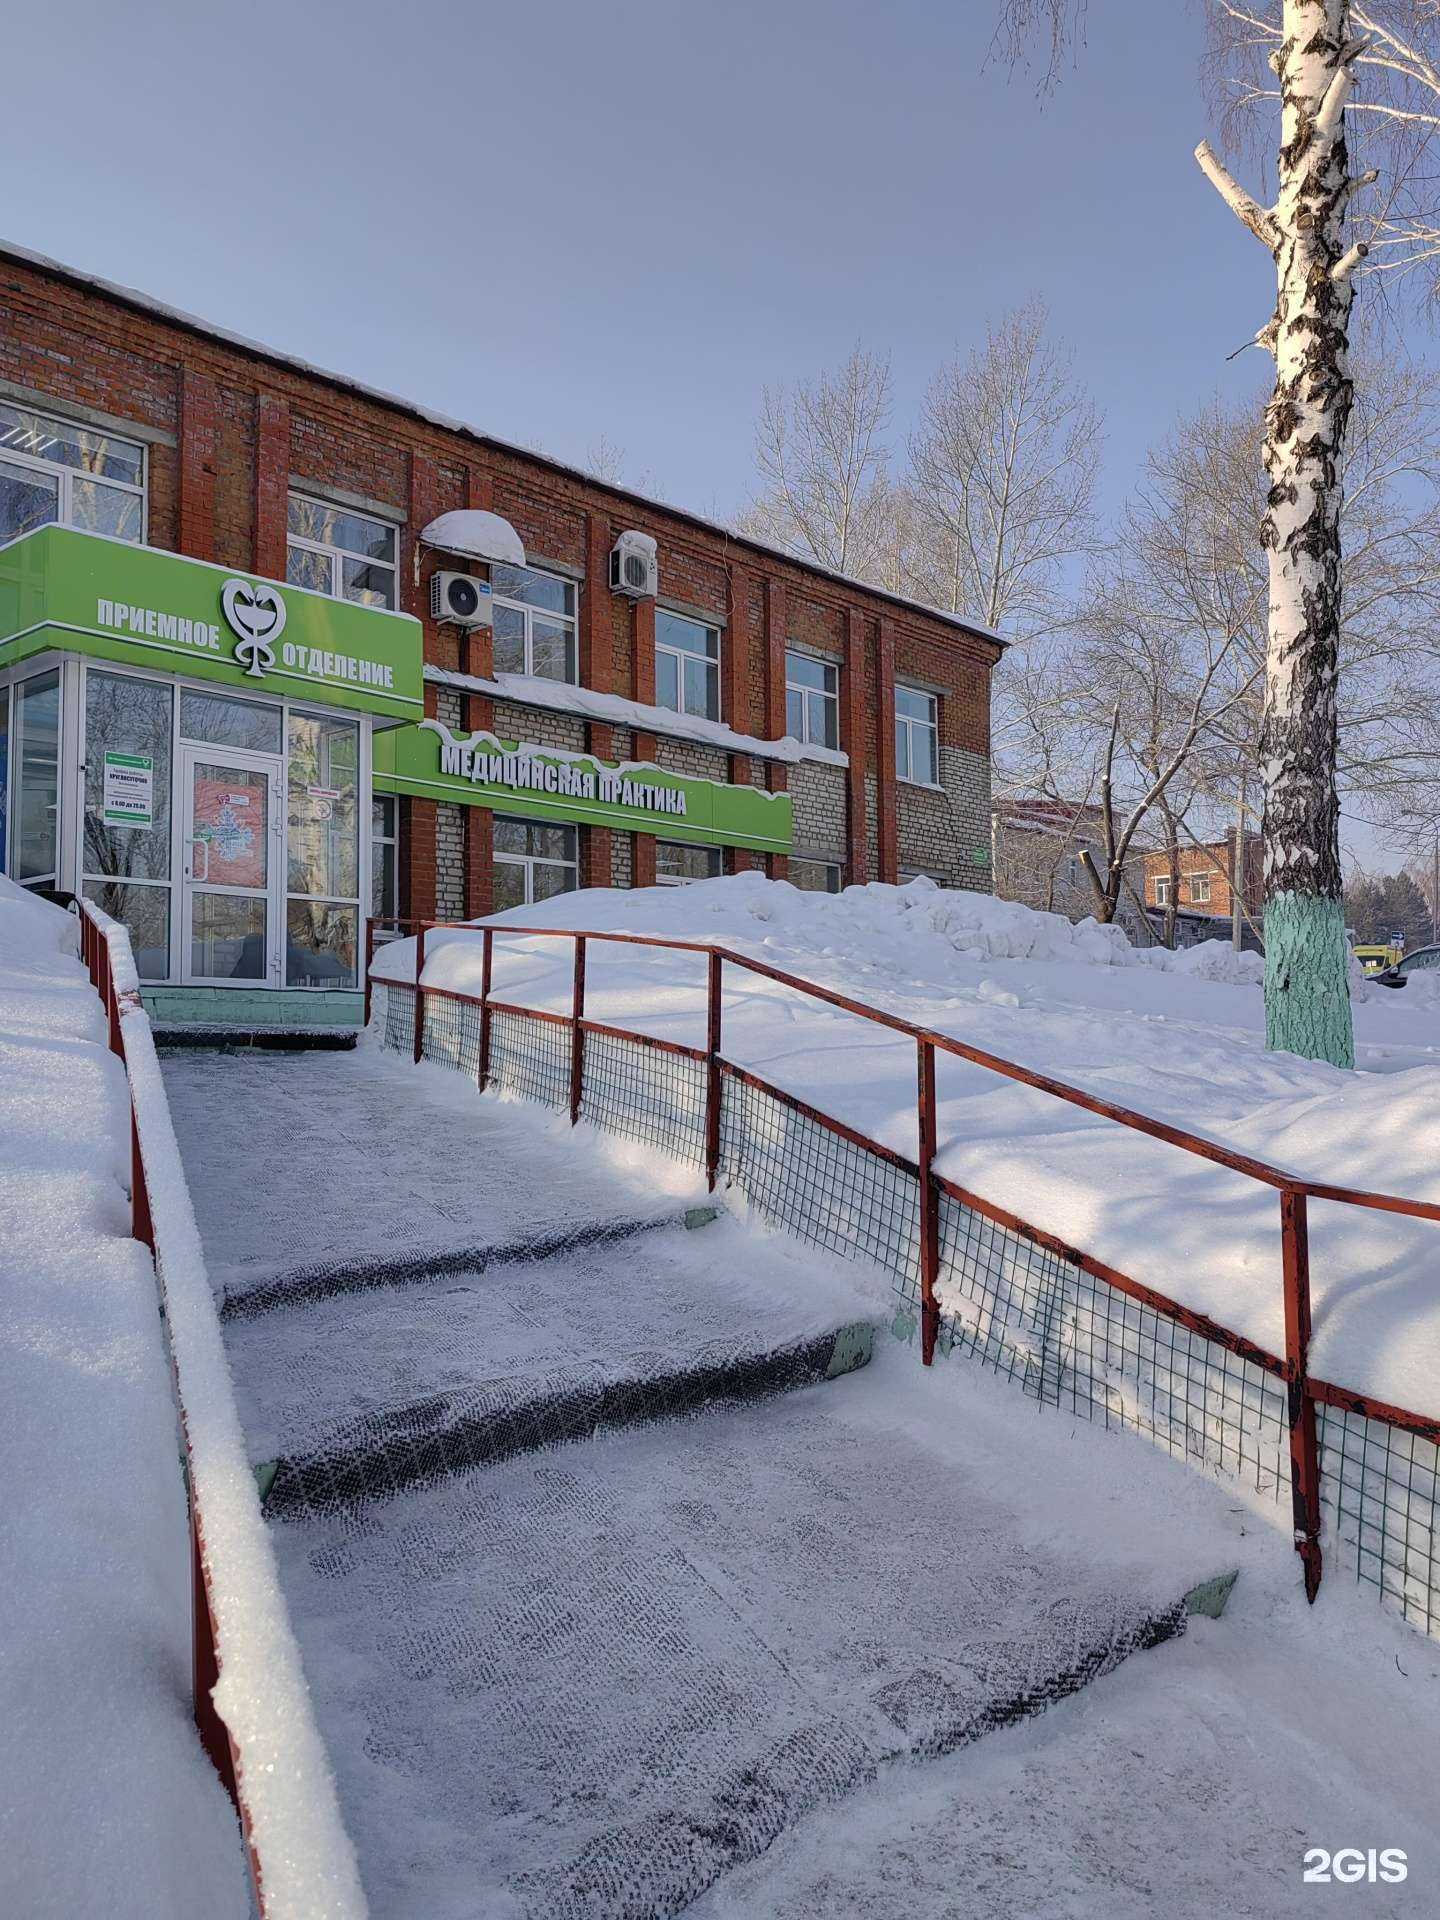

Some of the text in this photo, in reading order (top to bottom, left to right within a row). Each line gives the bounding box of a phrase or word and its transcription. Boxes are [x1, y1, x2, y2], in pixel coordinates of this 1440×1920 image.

[97, 598, 220, 650] ПРИЕМНОЕ
[282, 642, 394, 688] ОТДЕЛЕНИЕ
[441, 744, 687, 815] МЕДИЦИНСКАЯ ПРАКТИКА
